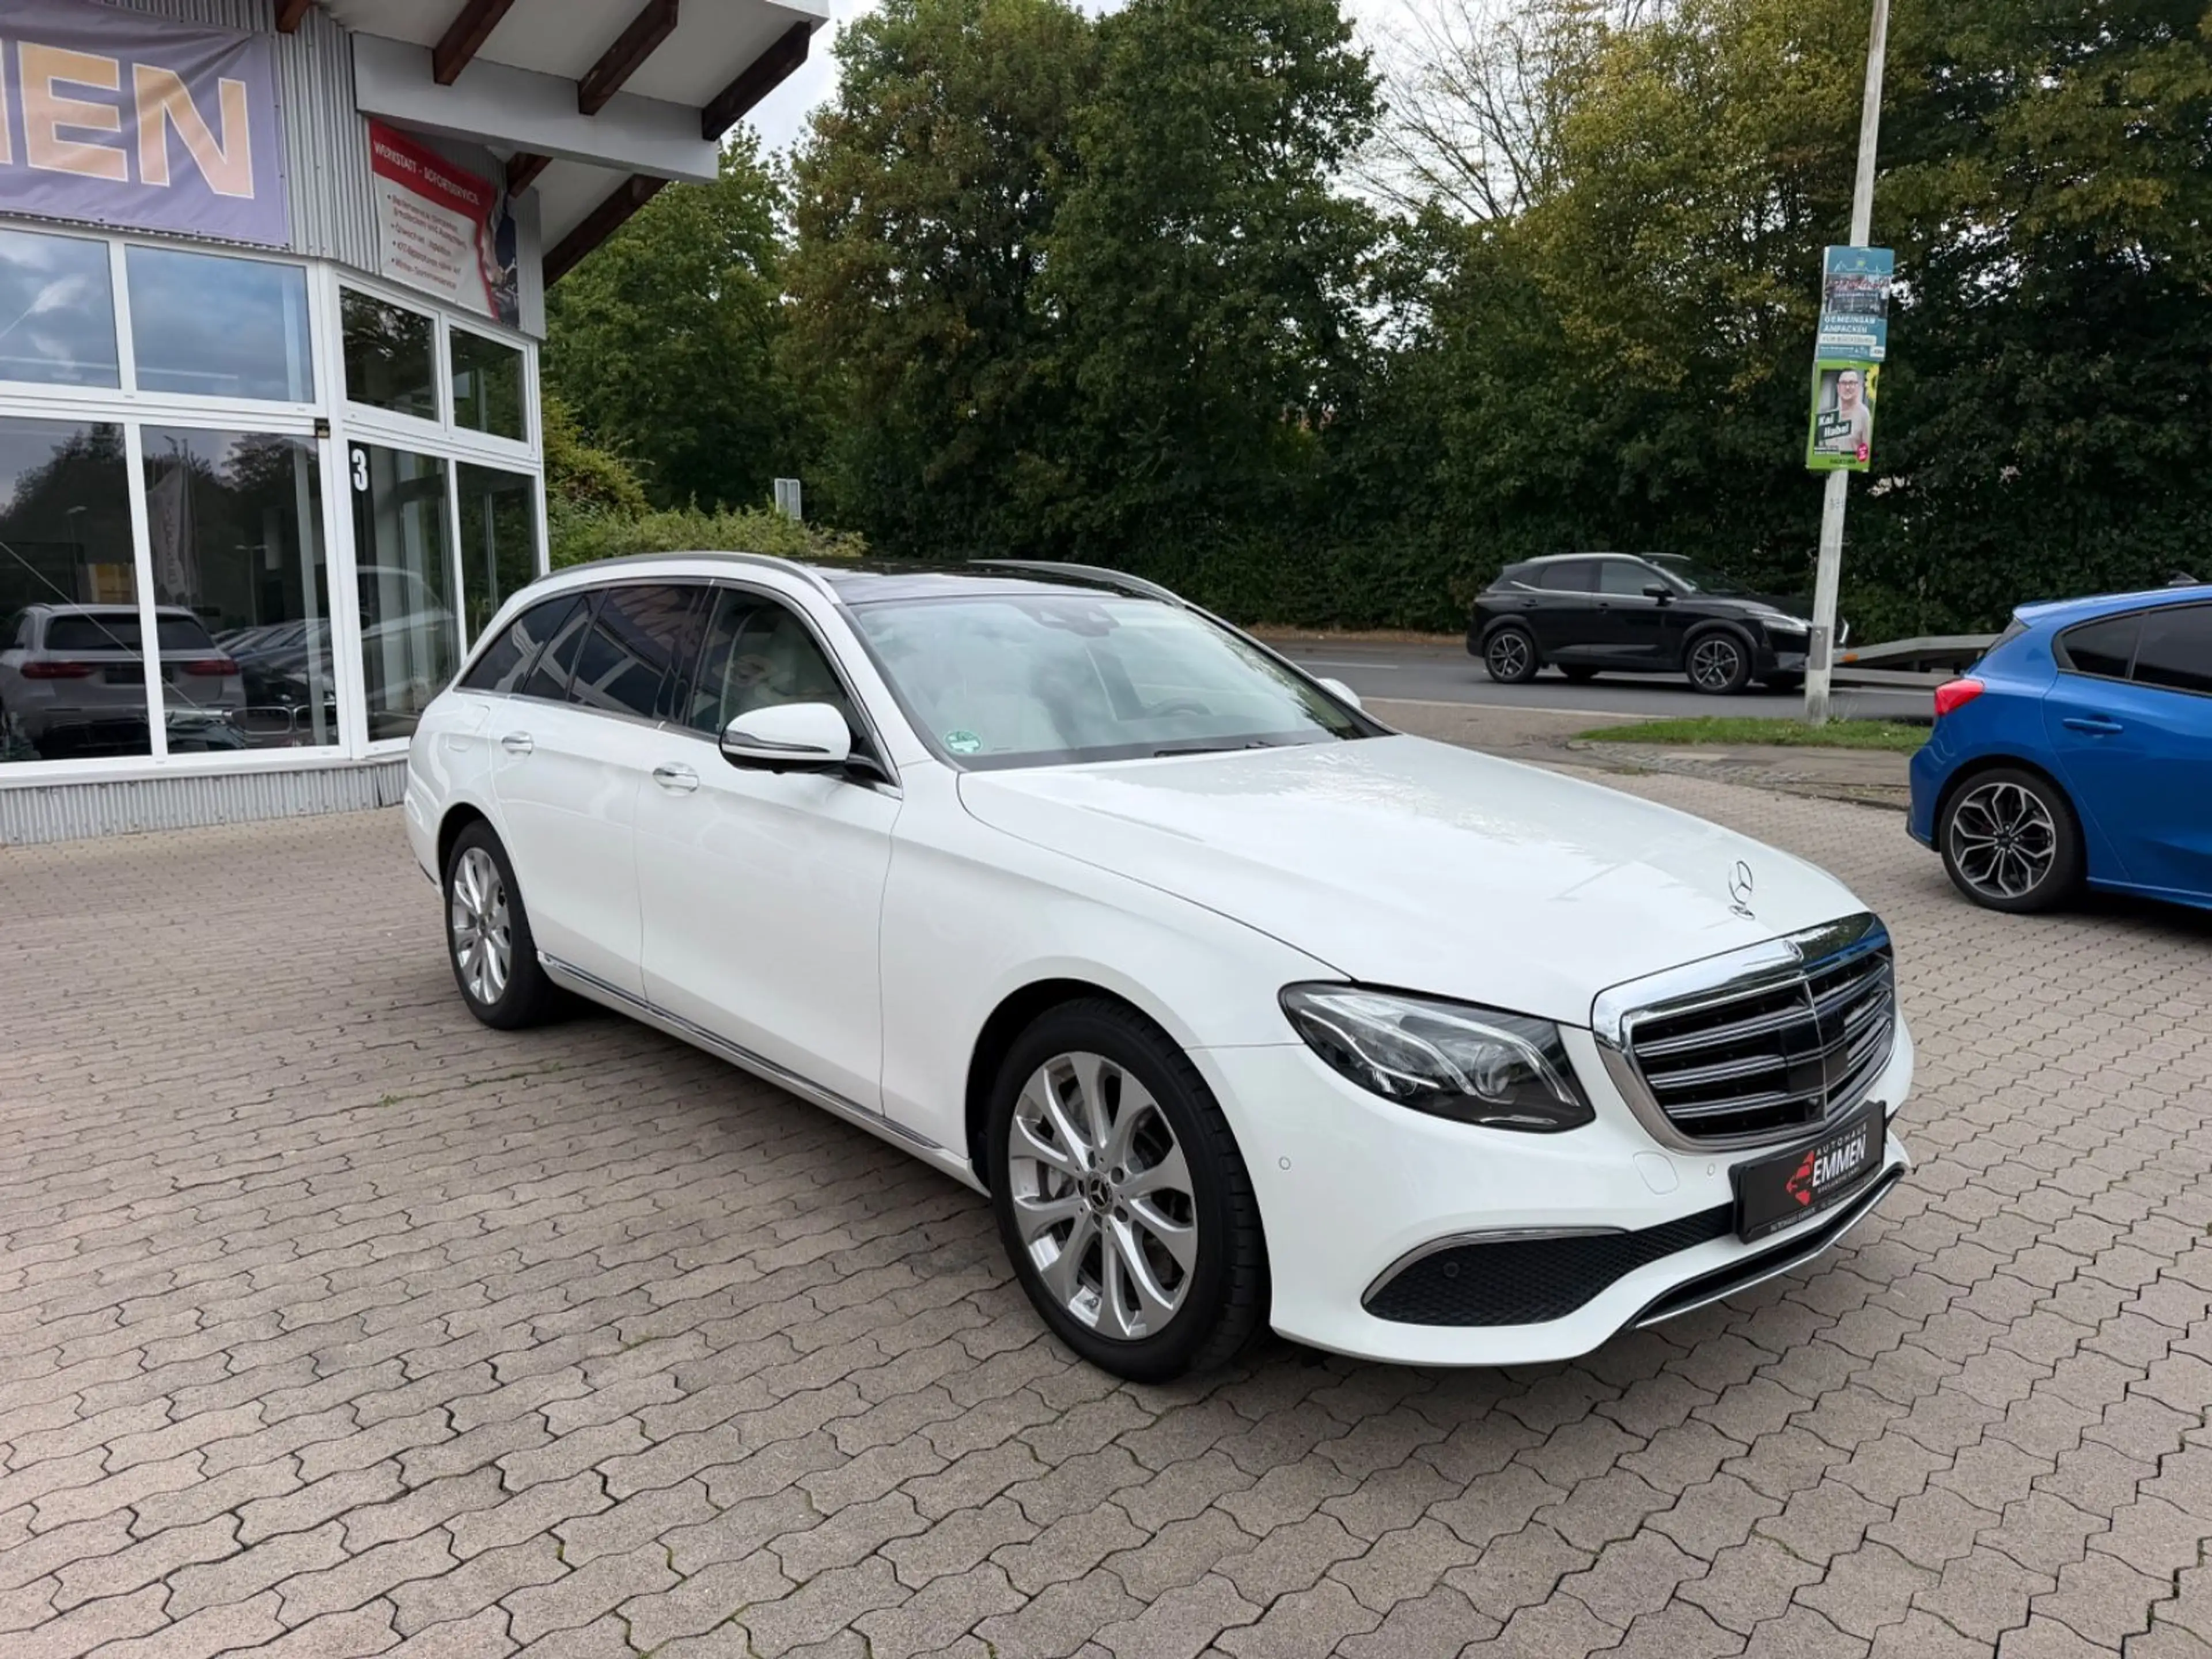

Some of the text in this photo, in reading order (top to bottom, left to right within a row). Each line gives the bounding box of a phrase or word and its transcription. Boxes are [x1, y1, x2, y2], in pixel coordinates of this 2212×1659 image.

[0, 37, 255, 200] EN
[373, 139, 416, 173] WERKSTATT
[1823, 324, 1868, 333] ANPACKEN
[1824, 315, 1876, 324] GEMEINSAM
[352, 449, 369, 492] 3
[1816, 1122, 1867, 1156] AUTOHAUS
[1812, 1133, 1866, 1187] EMMEN
